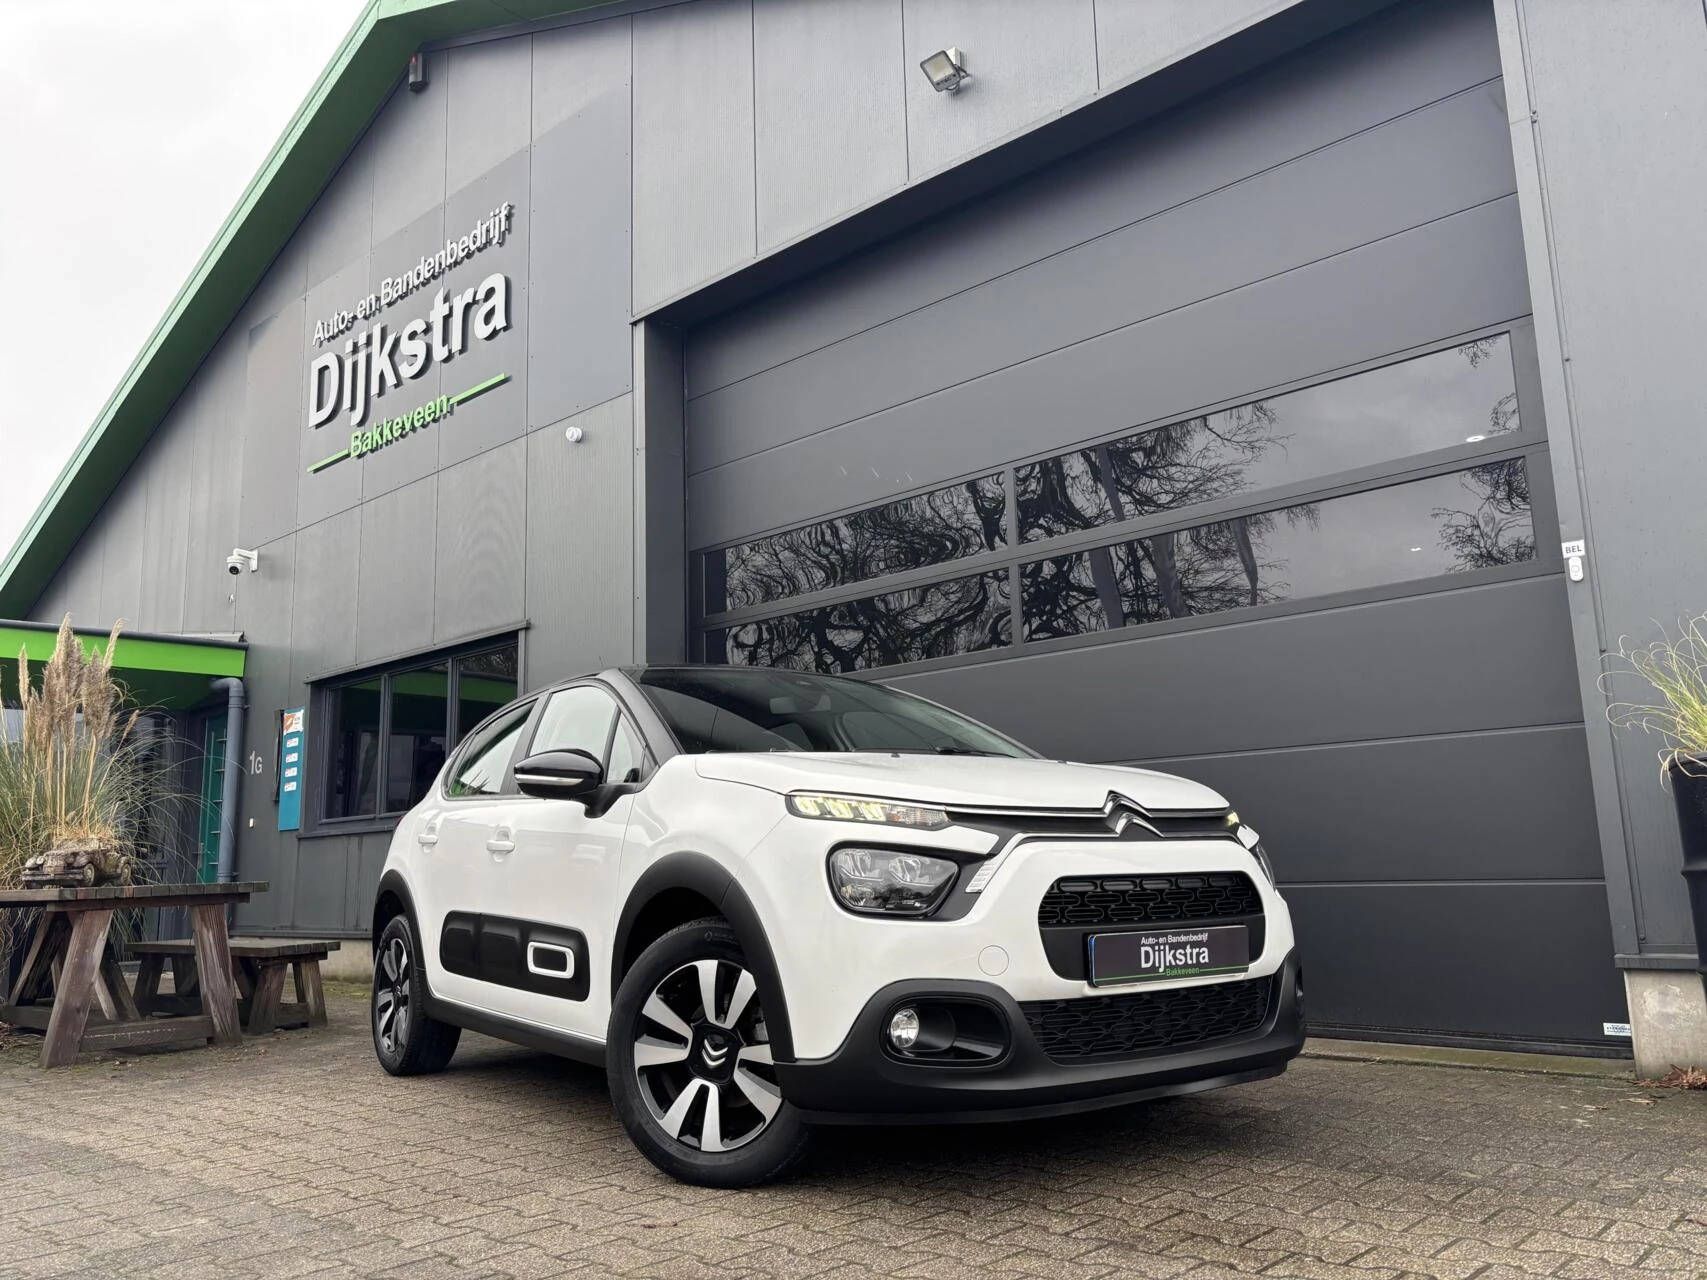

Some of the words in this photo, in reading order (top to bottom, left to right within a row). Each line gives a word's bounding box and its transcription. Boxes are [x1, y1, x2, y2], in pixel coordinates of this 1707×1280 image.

[313, 312, 356, 346] Auto-
[357, 292, 378, 319] en
[381, 202, 511, 306] Bandenbedrijf
[308, 272, 508, 427] Dijkstra
[350, 394, 449, 458] Bakkeveen
[1565, 545, 1583, 554] BEL
[250, 751, 262, 774] 1G
[1141, 936, 1158, 945] Auto-
[1168, 933, 1208, 942] Bandenbedrijf
[1141, 944, 1209, 972] Dijkstra
[1166, 968, 1199, 976] Bakkeveen
